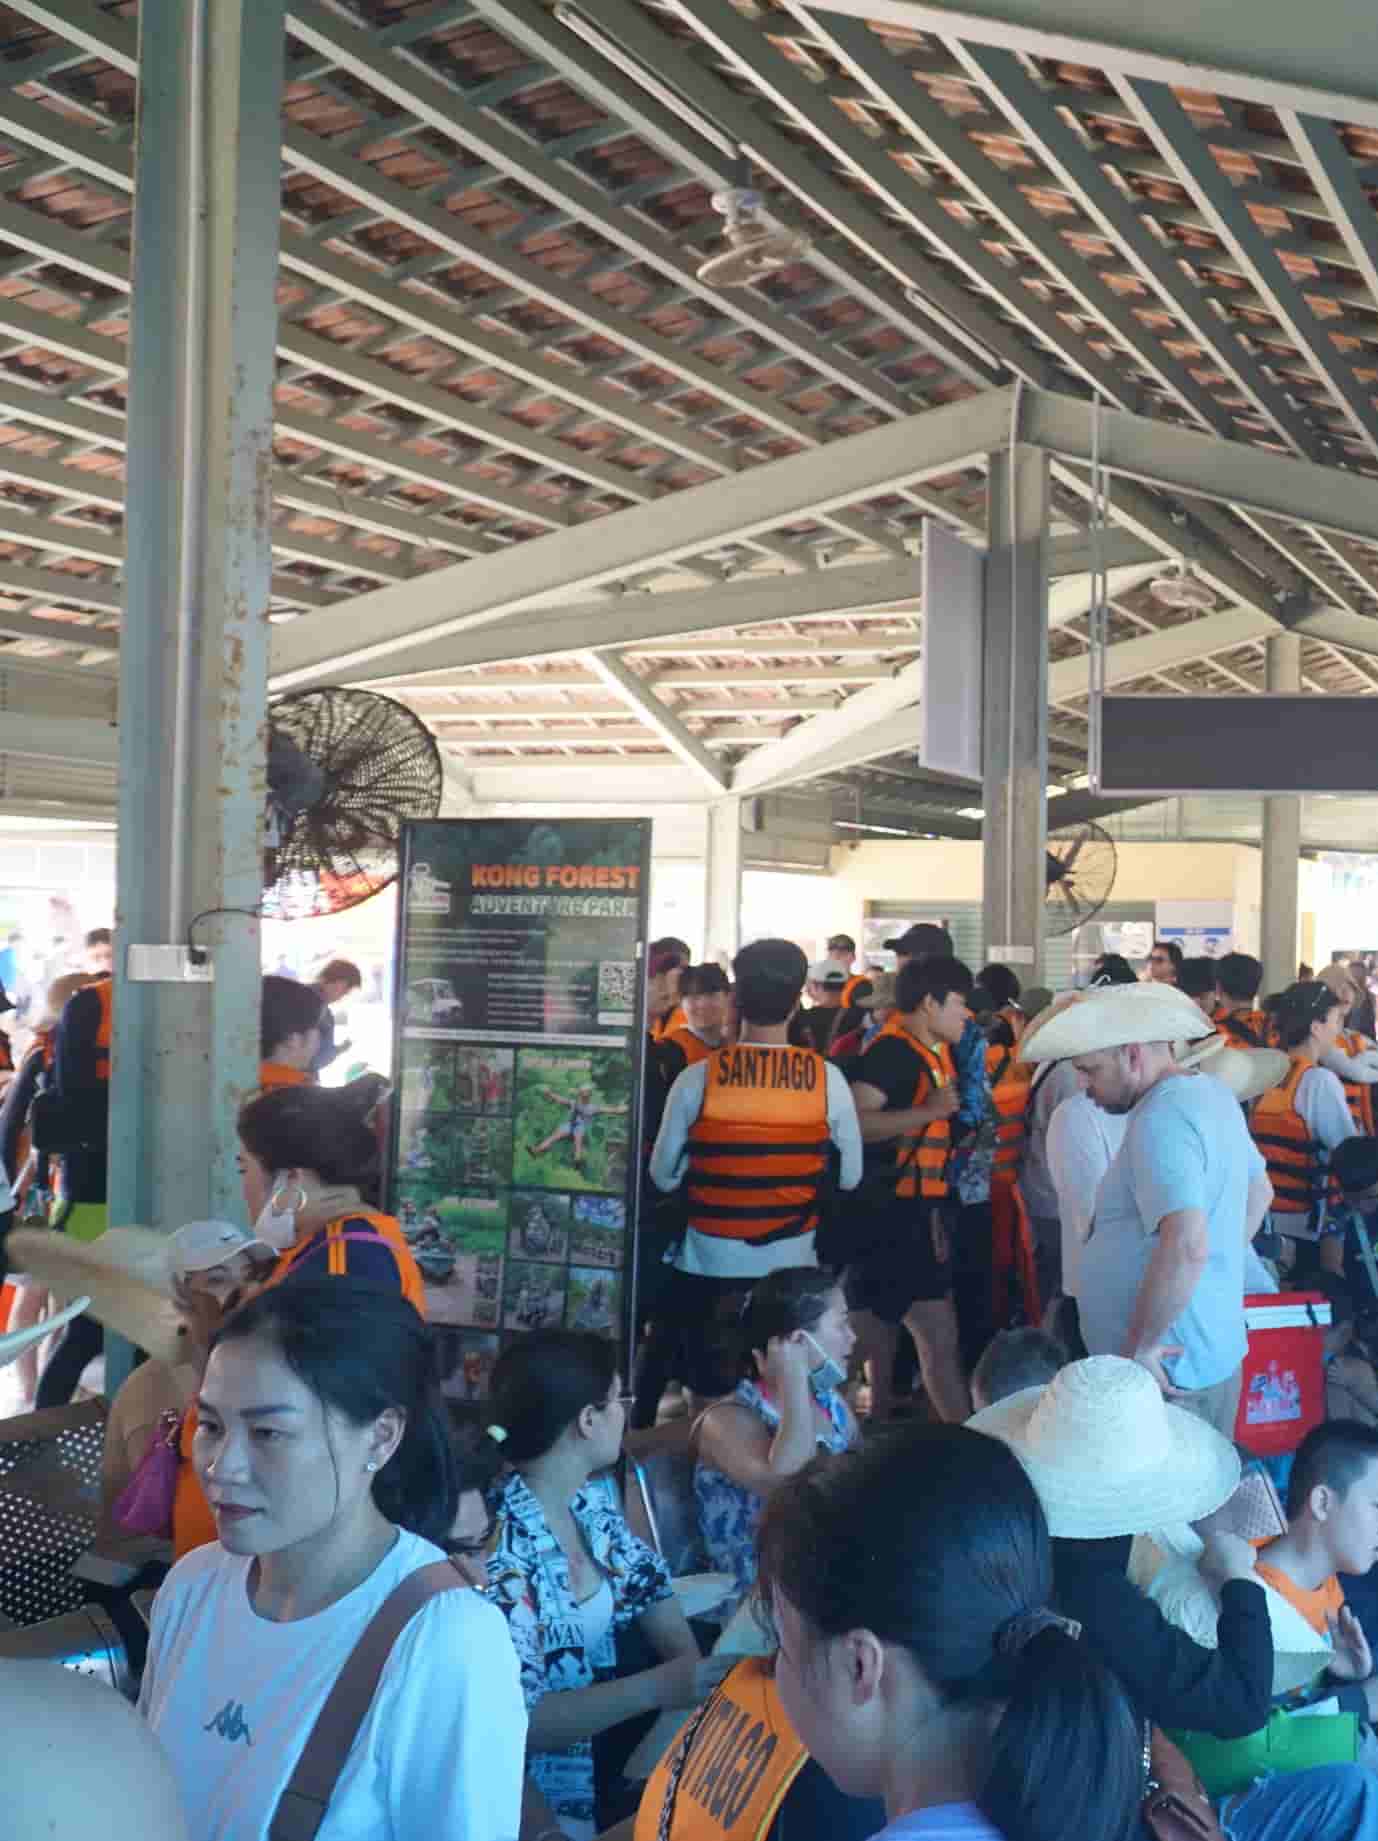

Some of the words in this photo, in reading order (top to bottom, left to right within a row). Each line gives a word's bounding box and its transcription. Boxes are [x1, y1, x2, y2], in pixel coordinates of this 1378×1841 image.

[472, 864, 540, 888] KONG
[545, 865, 640, 889] FOREST
[590, 896, 639, 917] PAR
[716, 1049, 817, 1092] SANTIAGO
[670, 1687, 778, 1830] NTIAGO
